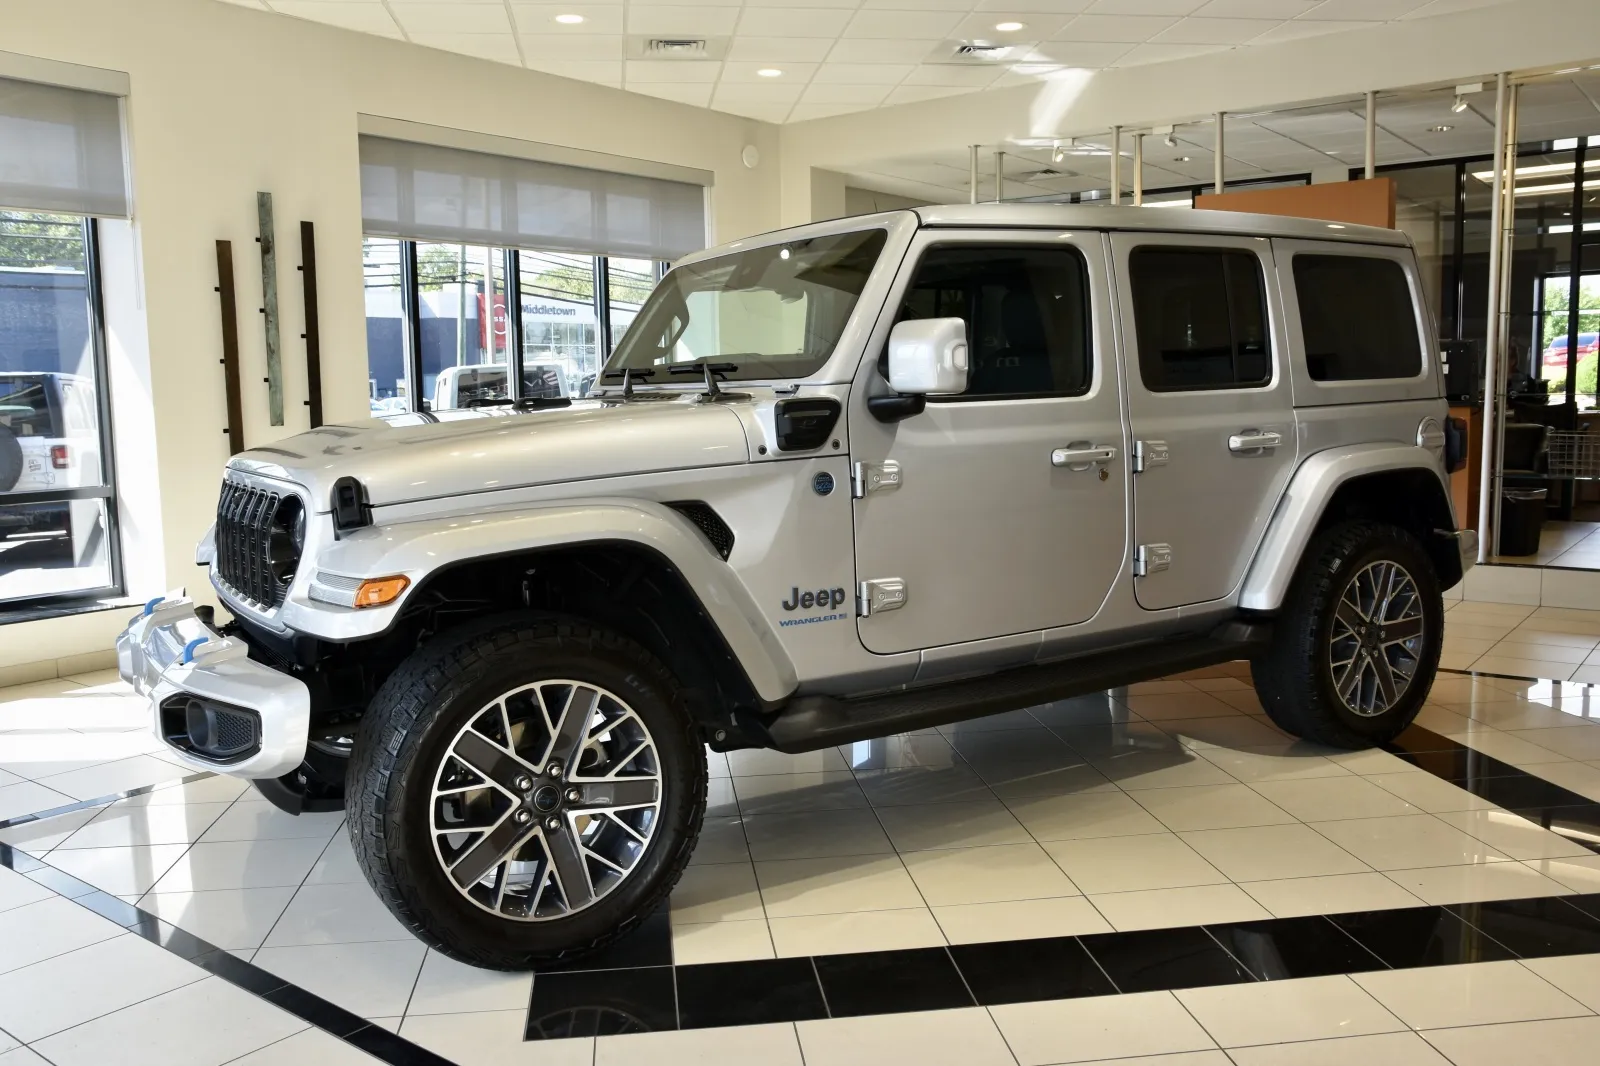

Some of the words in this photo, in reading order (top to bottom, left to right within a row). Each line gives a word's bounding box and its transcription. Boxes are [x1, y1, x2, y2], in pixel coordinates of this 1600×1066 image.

[521, 304, 576, 316] Middletown
[782, 587, 846, 611] Jeep
[779, 614, 837, 627] WRANGLER
